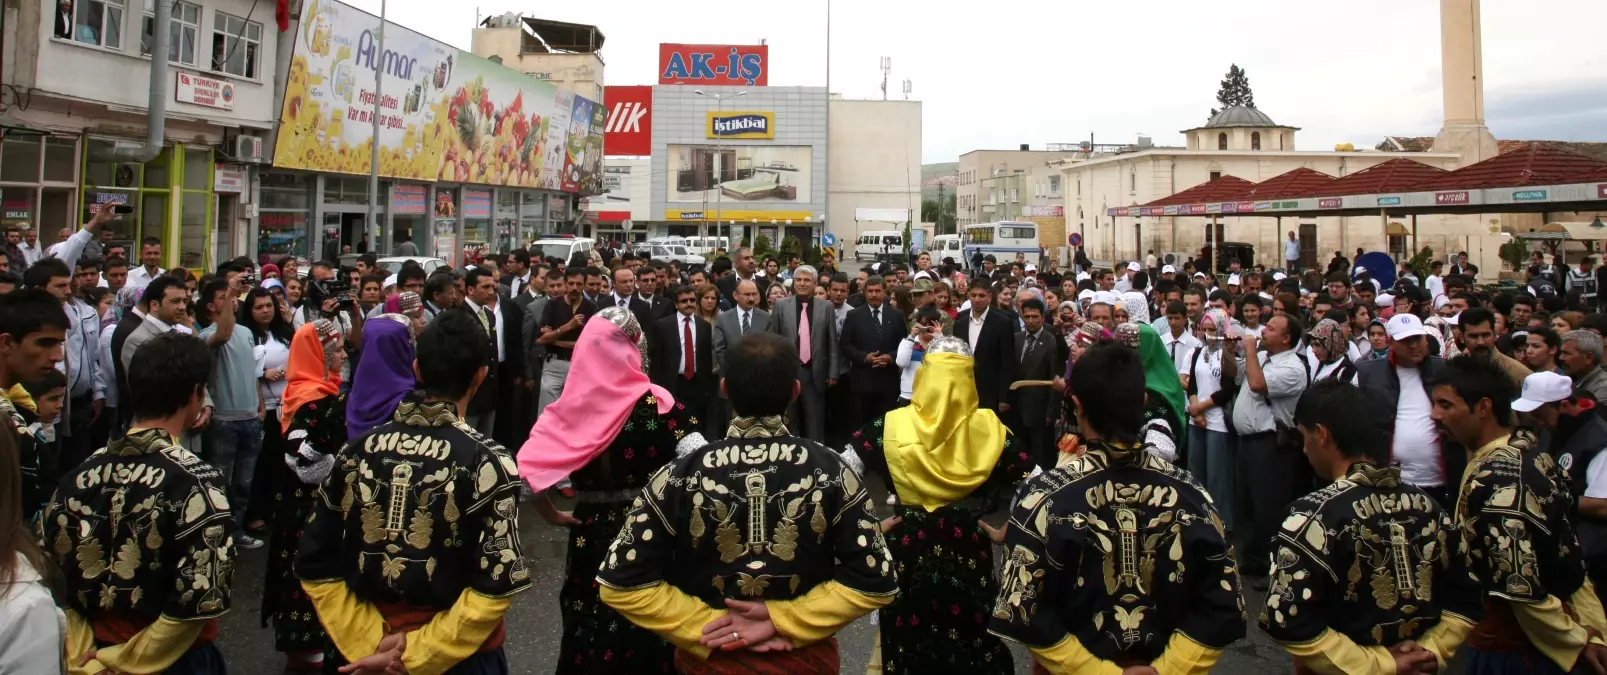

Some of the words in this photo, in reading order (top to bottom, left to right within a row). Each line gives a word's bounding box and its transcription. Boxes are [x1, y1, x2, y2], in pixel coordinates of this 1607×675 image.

[662, 47, 761, 87] AK-İŞ
[380, 93, 398, 110] alitesi
[368, 110, 387, 127] Ayar
[604, 102, 647, 133] lik
[714, 116, 766, 131] istikbal
